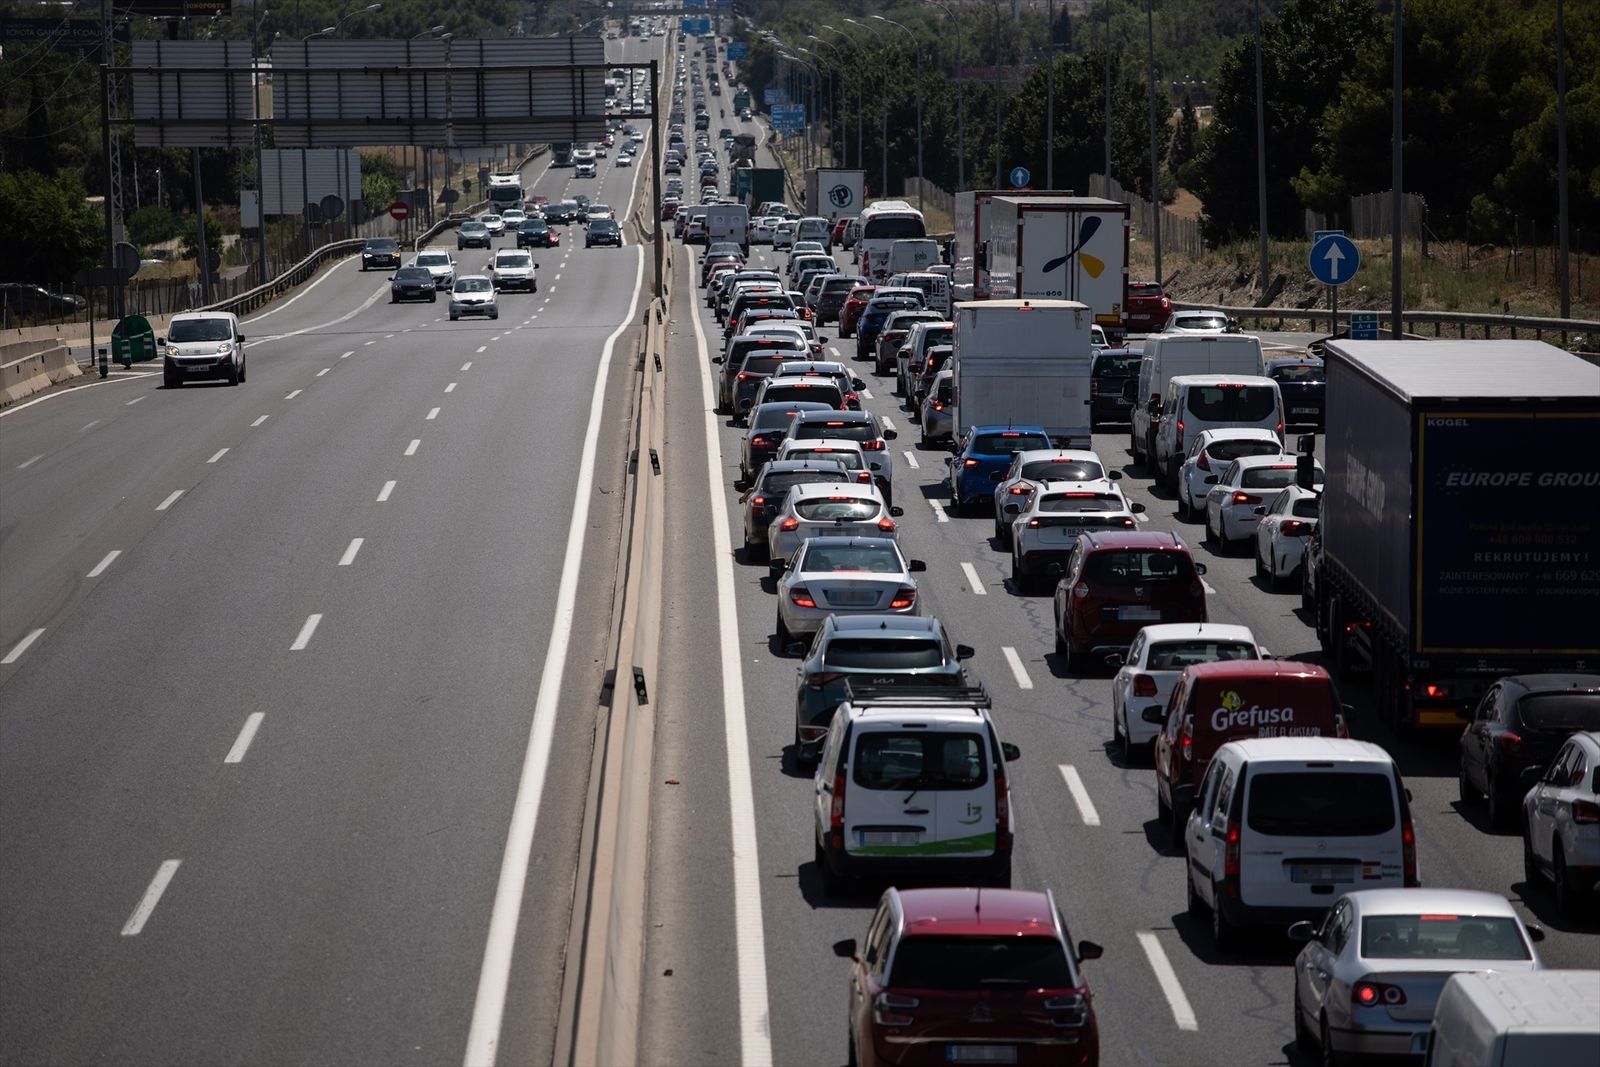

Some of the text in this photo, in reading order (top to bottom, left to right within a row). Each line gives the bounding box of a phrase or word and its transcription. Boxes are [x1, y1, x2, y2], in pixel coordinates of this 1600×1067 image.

[1445, 472, 1600, 487] EUROPE GROU
[1554, 569, 1577, 581] 669
[1211, 704, 1294, 732] Grefusa
